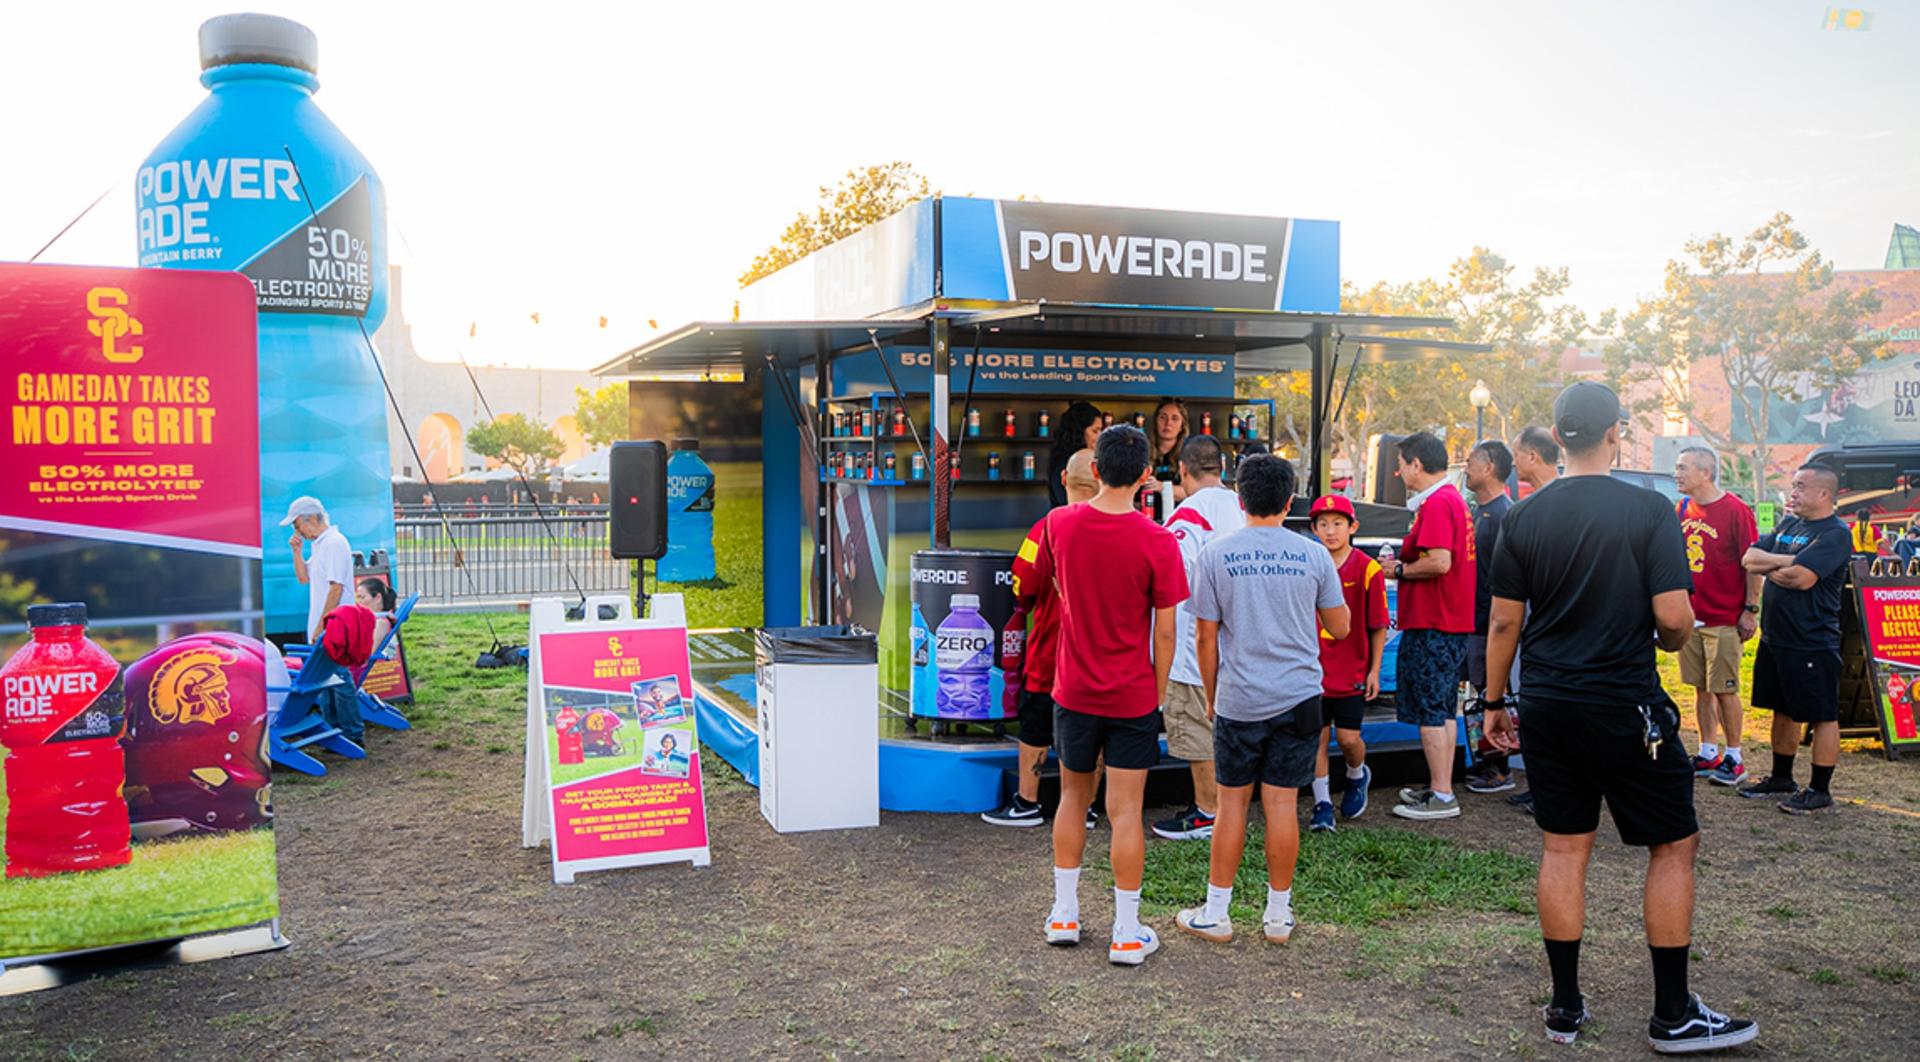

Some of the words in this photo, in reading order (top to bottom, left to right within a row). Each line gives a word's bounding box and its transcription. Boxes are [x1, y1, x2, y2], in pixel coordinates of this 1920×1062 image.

[139, 158, 301, 207] POWER
[307, 226, 368, 262] 50%
[182, 247, 222, 261] BERRY
[1019, 230, 1268, 282] POWERADE
[308, 258, 369, 284] MORE
[87, 286, 144, 363] SC
[964, 353, 1035, 368] MORE
[1043, 355, 1226, 373] ELECTROLYTES
[980, 372, 996, 380] vs
[999, 371, 1020, 380] the
[1022, 371, 1073, 382] Leading
[1076, 372, 1120, 383] Sports
[1122, 373, 1156, 383] Drink
[17, 373, 132, 402] GAMEDAY
[139, 375, 210, 403] TAKES
[1894, 400, 1915, 417] DA
[12, 405, 120, 445] MORE
[132, 406, 216, 445] GRIT
[39, 465, 106, 479] 50%
[113, 464, 195, 478] MORE
[29, 480, 203, 493] ELECTROLYTES
[55, 494, 74, 503] the
[76, 494, 123, 504] Leading
[125, 493, 165, 503] Sports
[167, 492, 198, 502] Drink
[1223, 552, 1251, 564] Men
[1255, 550, 1277, 562] For
[1280, 550, 1307, 563] And
[1226, 564, 1258, 578] With
[1260, 564, 1306, 577] Others
[1884, 604, 1920, 621] PLEASE
[1881, 622, 1920, 638] RECYCL
[937, 636, 987, 651] ZERO
[4, 672, 97, 698] POWER
[6, 696, 54, 718] ADE
